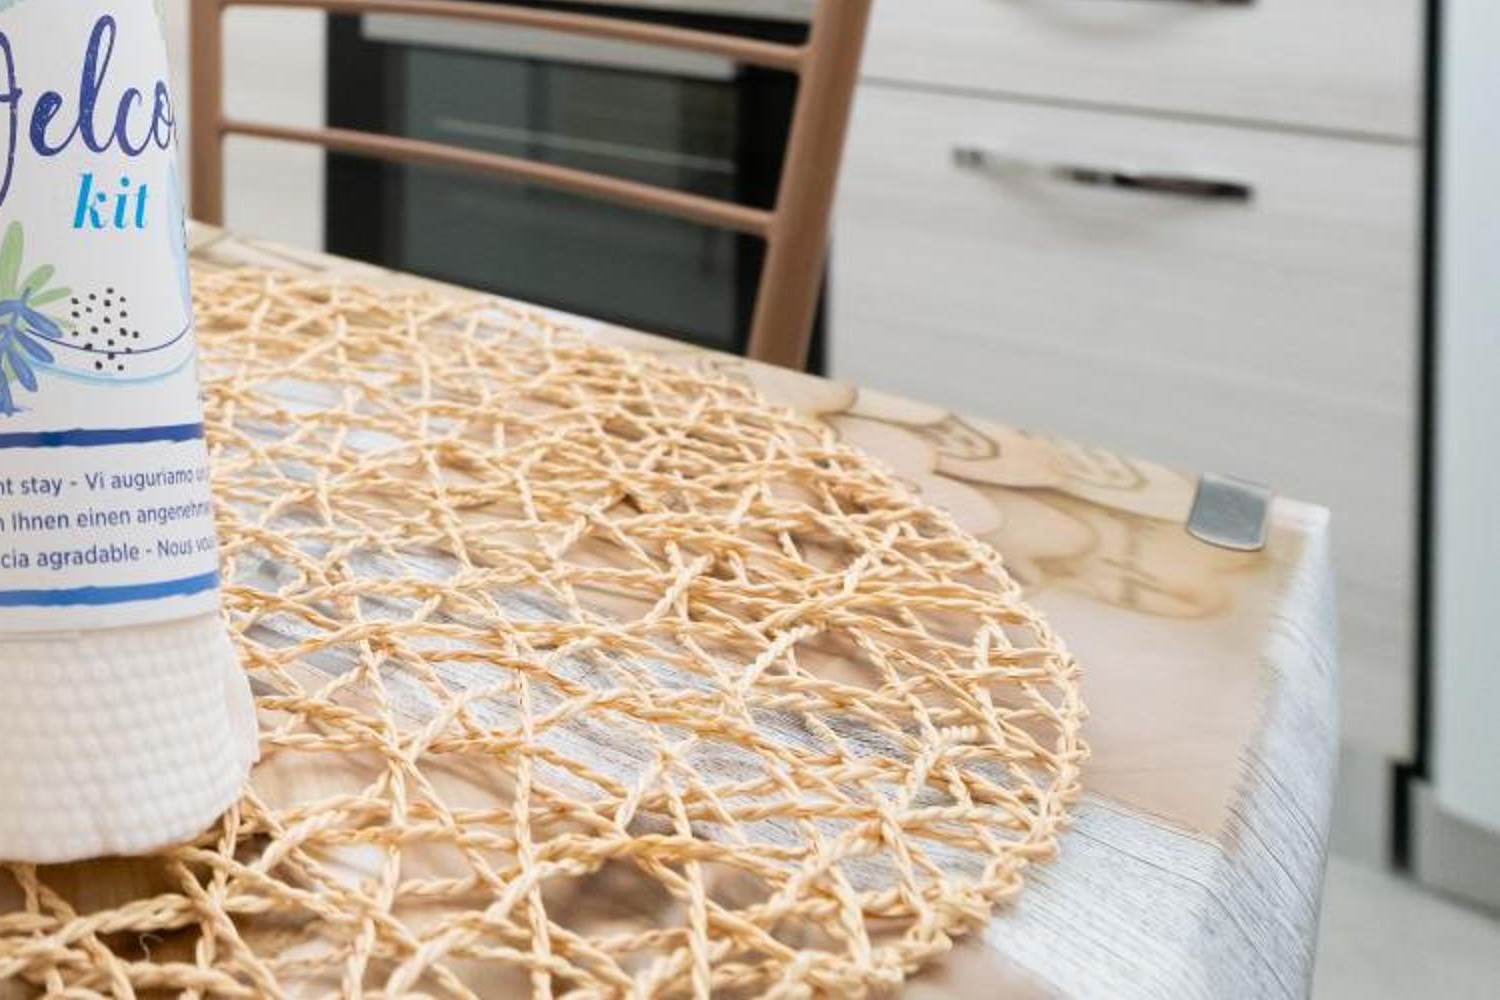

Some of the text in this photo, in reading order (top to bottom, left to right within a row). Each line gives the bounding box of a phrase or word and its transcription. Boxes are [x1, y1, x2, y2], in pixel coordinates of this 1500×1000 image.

[73, 172, 148, 230] kit
[20, 475, 62, 497] stay
[84, 470, 105, 491] Vi
[111, 467, 194, 492] auguriamo
[11, 511, 69, 533] Ihnen
[77, 506, 131, 528] einen
[37, 542, 140, 571] agradable
[157, 538, 193, 558] Nous
